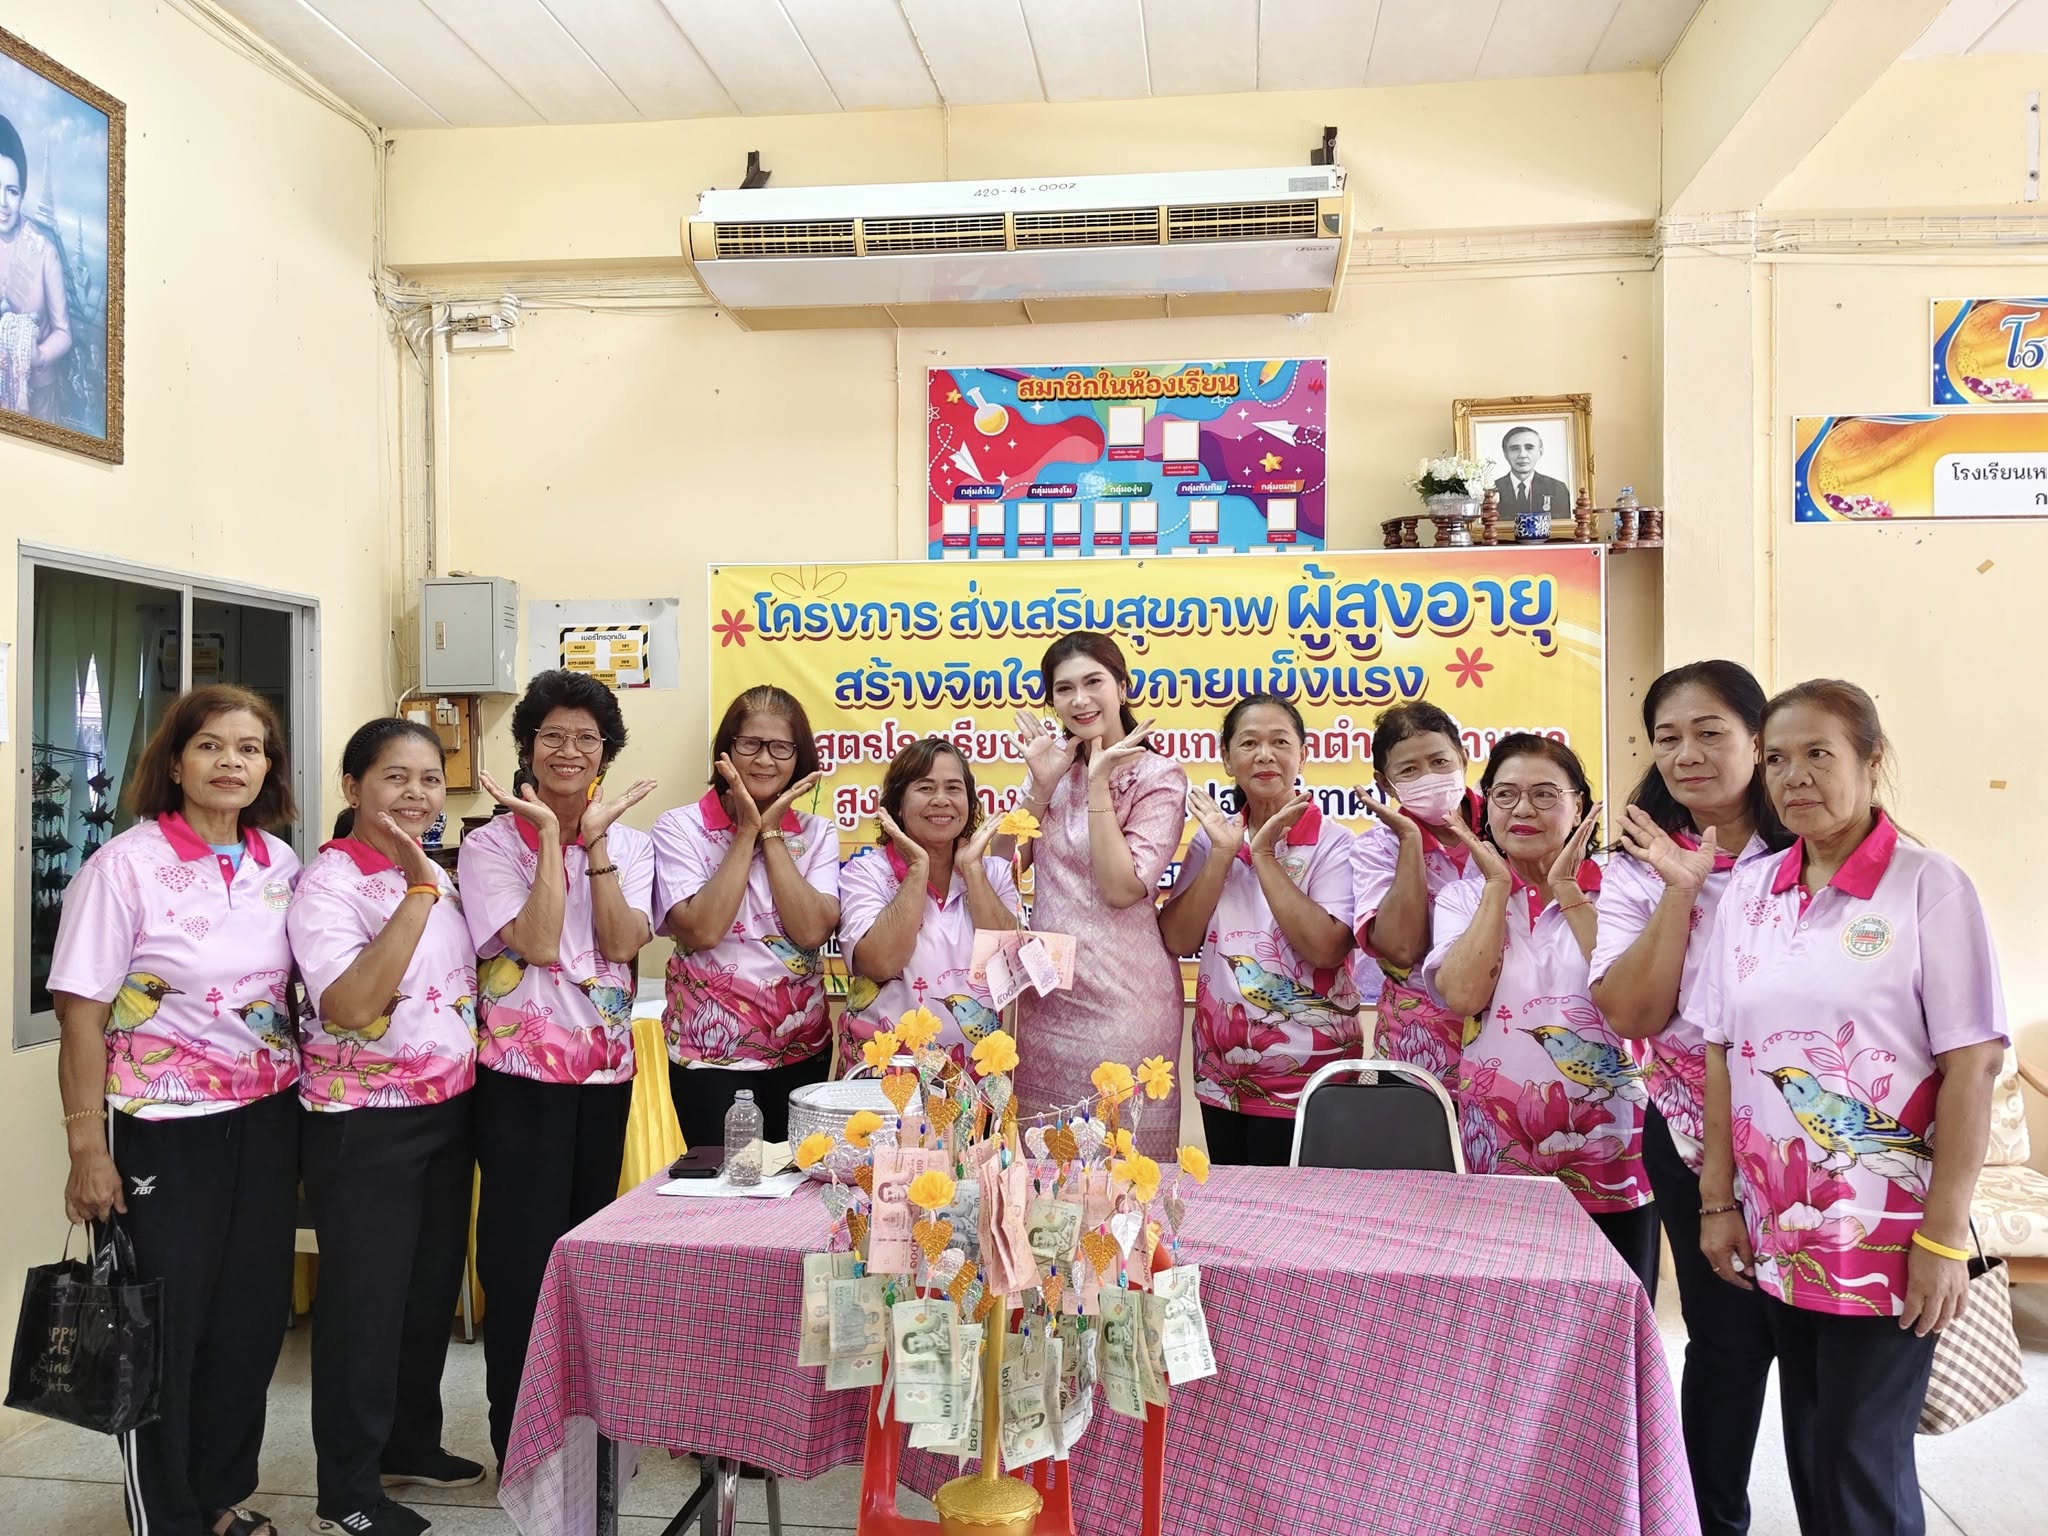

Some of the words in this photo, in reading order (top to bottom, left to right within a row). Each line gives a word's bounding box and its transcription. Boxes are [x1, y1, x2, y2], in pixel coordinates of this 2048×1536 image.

[1018, 369, 1238, 399] สมาชิกในห้องเรียน
[753, 591, 939, 636] โครงการ
[949, 580, 1273, 647] ส่งเสริมสุขภาพ
[1287, 563, 1553, 652] ผู้สูงอายุ
[834, 656, 1046, 703] สร้างจิตใจ
[1126, 648, 1425, 702] งกายแข็งแรง
[131, 1186, 156, 1195] FBT
